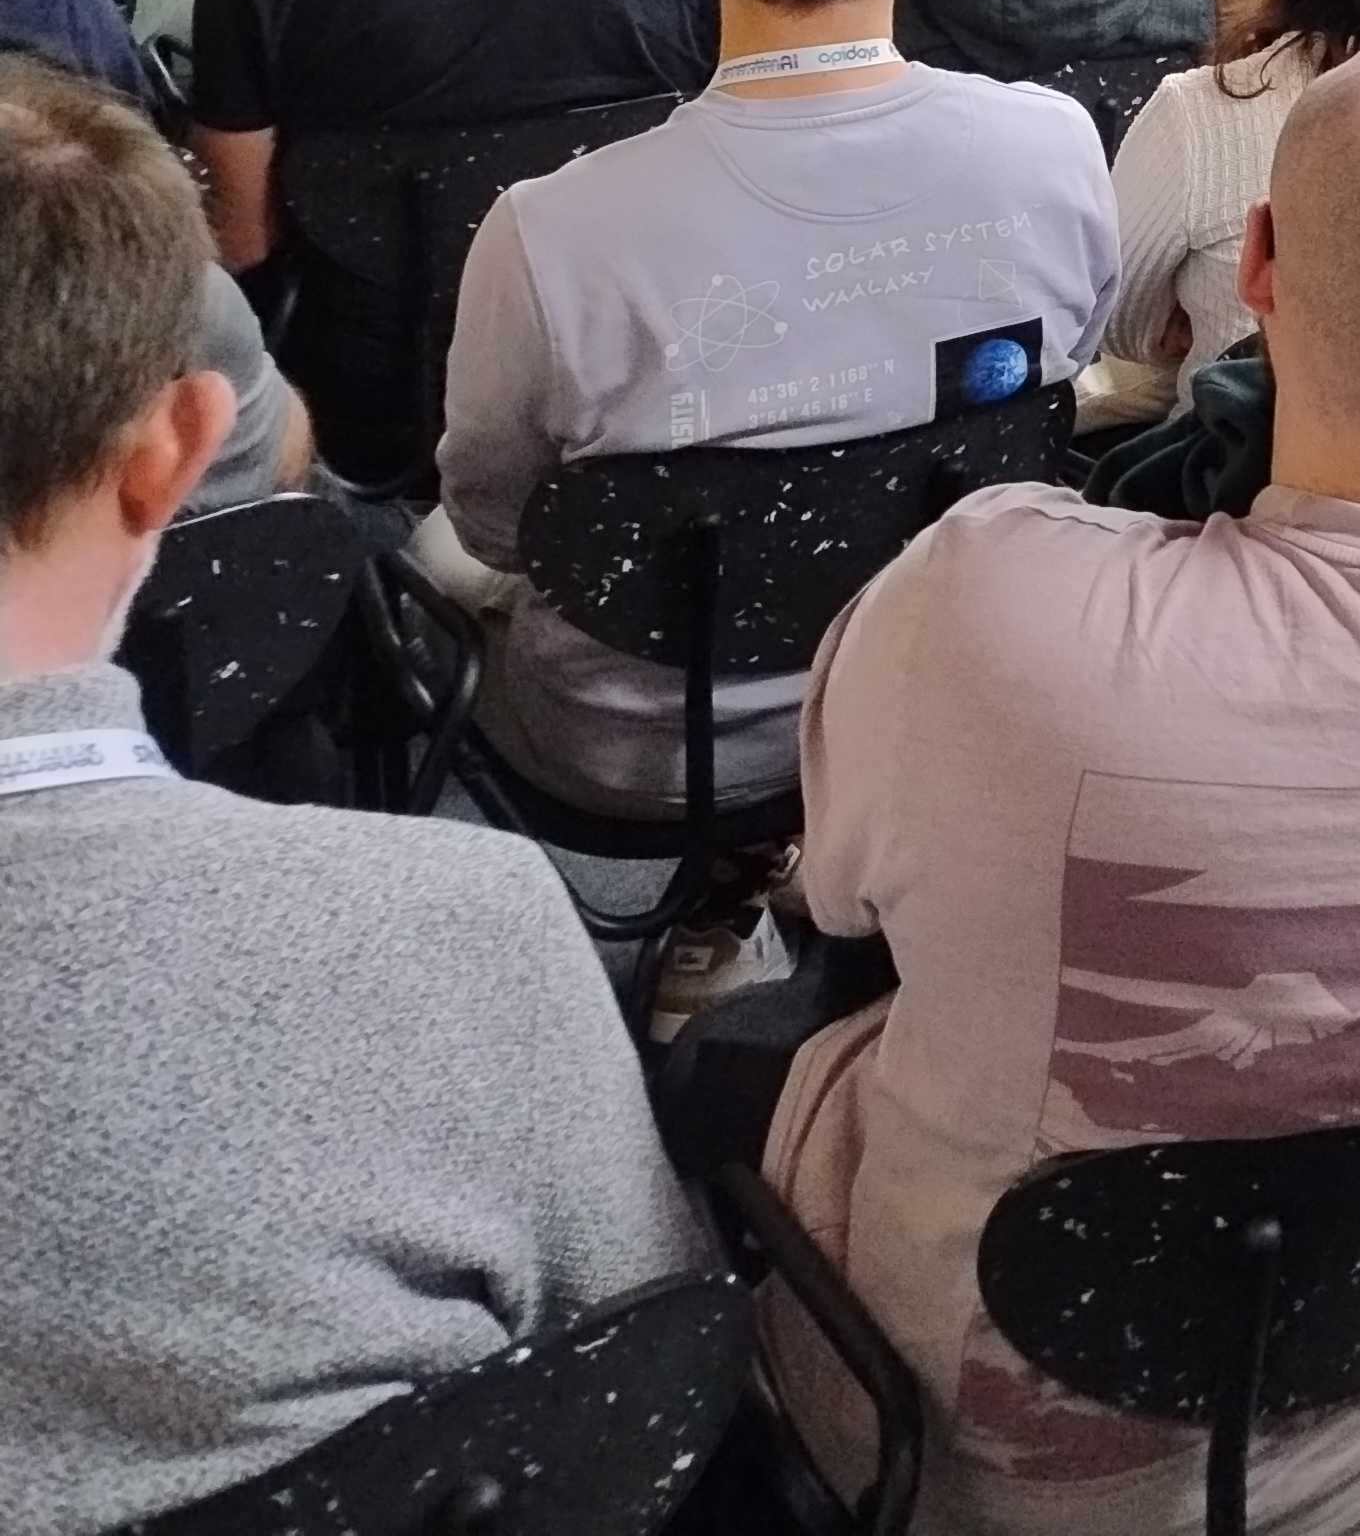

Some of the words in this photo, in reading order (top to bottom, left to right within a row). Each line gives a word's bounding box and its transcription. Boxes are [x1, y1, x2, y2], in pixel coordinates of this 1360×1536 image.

[818, 42, 880, 65] apidays
[805, 236, 911, 280] SOLAR
[925, 211, 1032, 252] SYSTEM
[802, 265, 935, 312] WAALAXY
